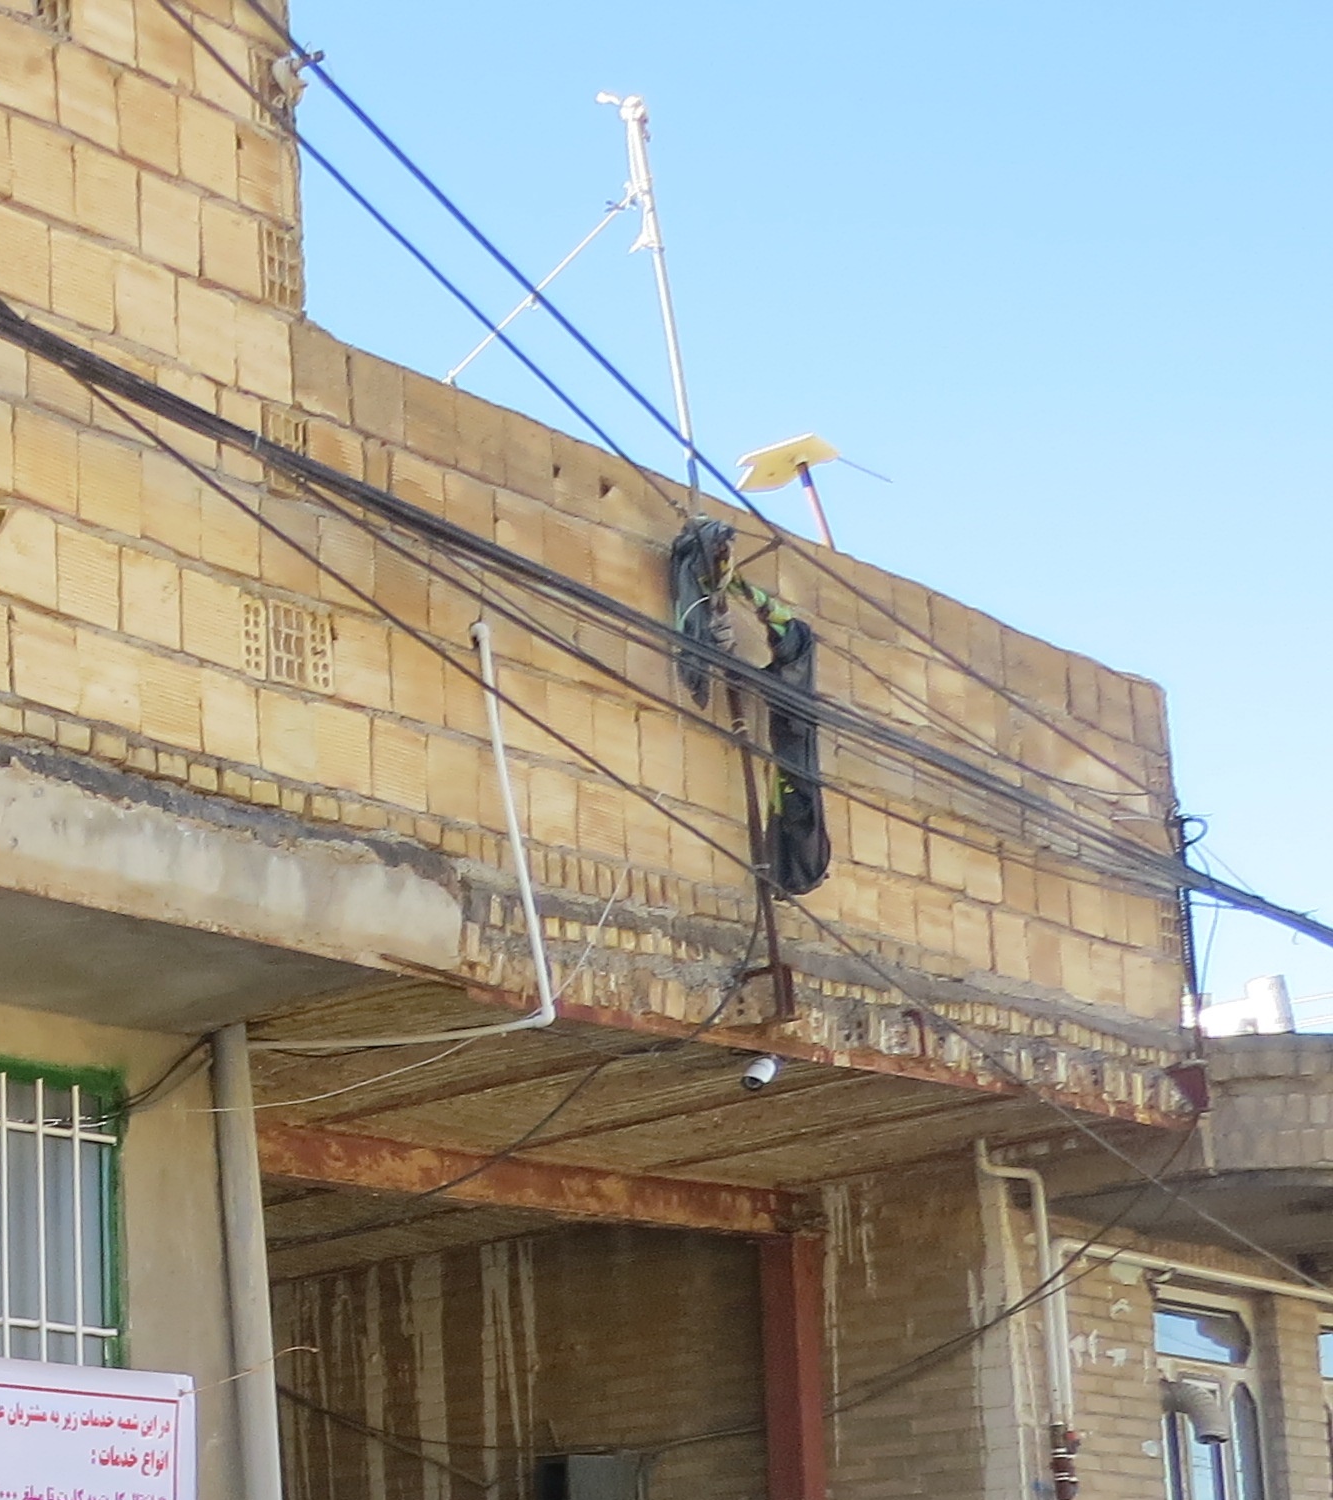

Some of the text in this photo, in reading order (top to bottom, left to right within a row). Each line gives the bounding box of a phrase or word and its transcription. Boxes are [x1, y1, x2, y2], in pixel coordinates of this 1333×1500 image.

[7, 1403, 47, 1426] مشتریان
[50, 1411, 59, 1429] به
[62, 1412, 78, 1431] زیر
[81, 1410, 115, 1427] خدمات
[117, 1415, 138, 1434] شعبه
[141, 1416, 157, 1437] این
[158, 1416, 170, 1438] در
[141, 1450, 168, 1476] انواع
